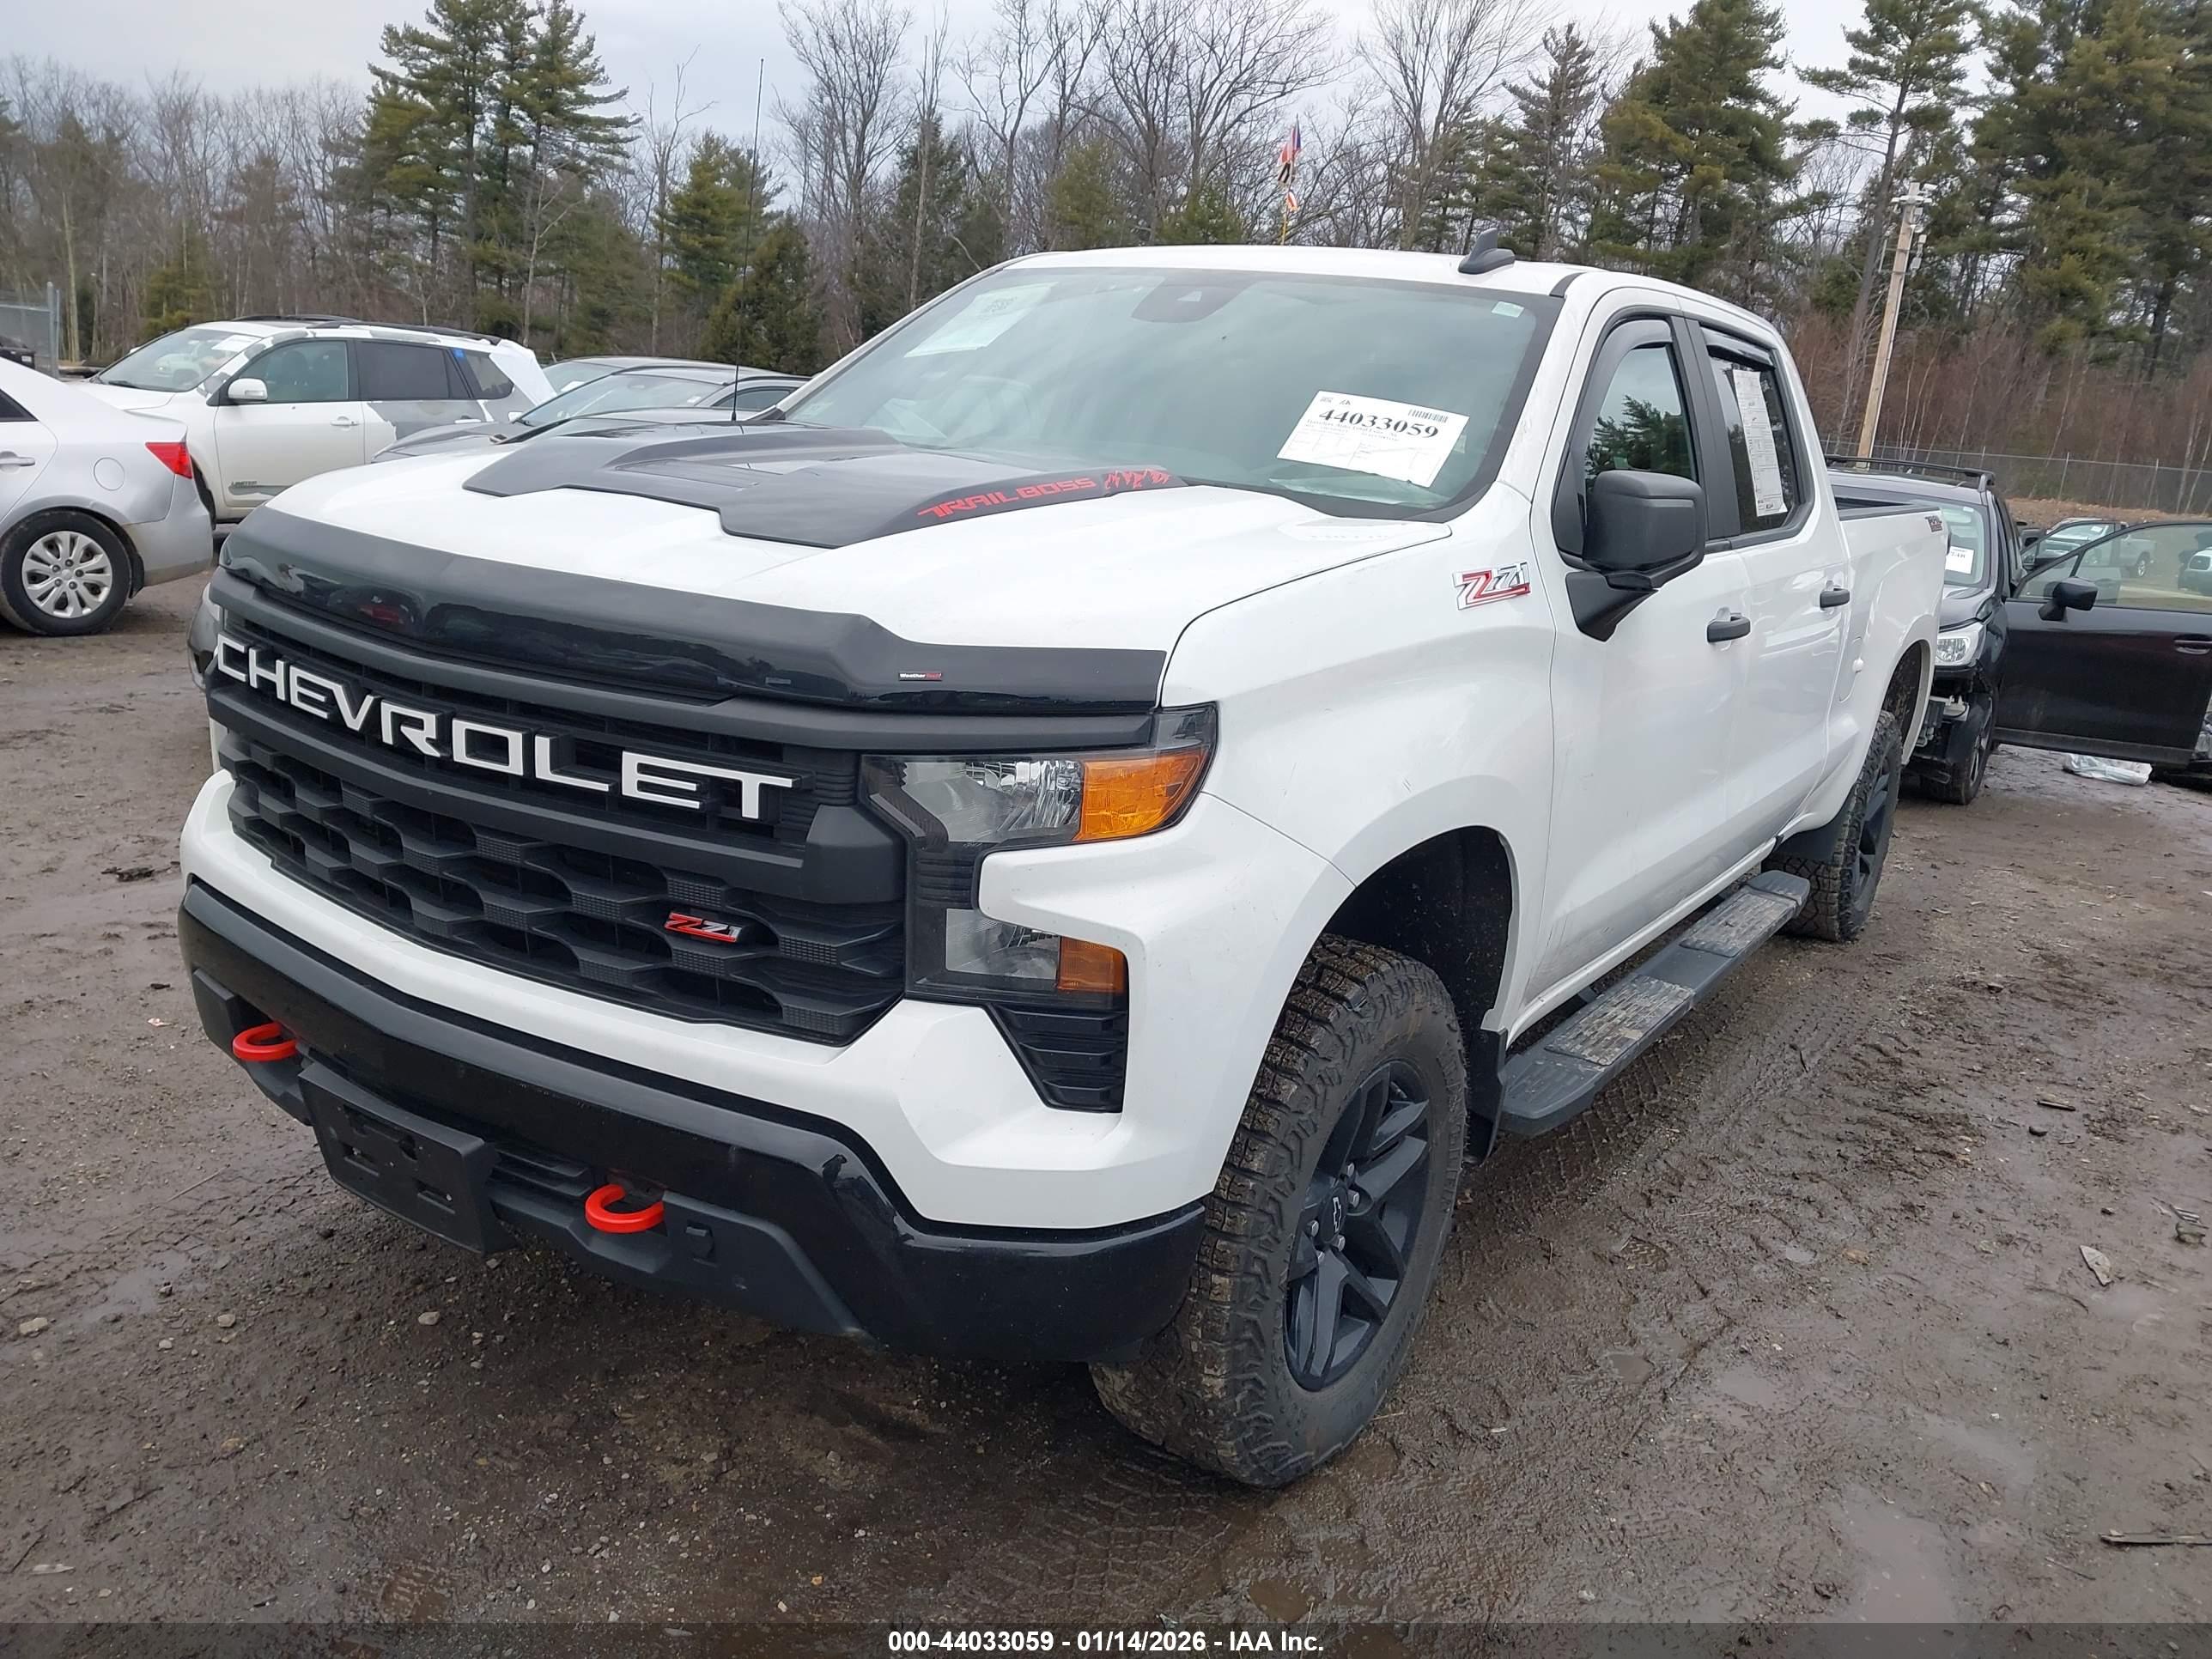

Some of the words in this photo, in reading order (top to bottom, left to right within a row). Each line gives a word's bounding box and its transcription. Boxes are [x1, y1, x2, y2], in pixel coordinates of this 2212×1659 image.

[1318, 408, 1439, 439] 44033059
[1452, 562, 1531, 610] Z71
[216, 632, 797, 819] CHEVROLET
[664, 912, 743, 943] Z71
